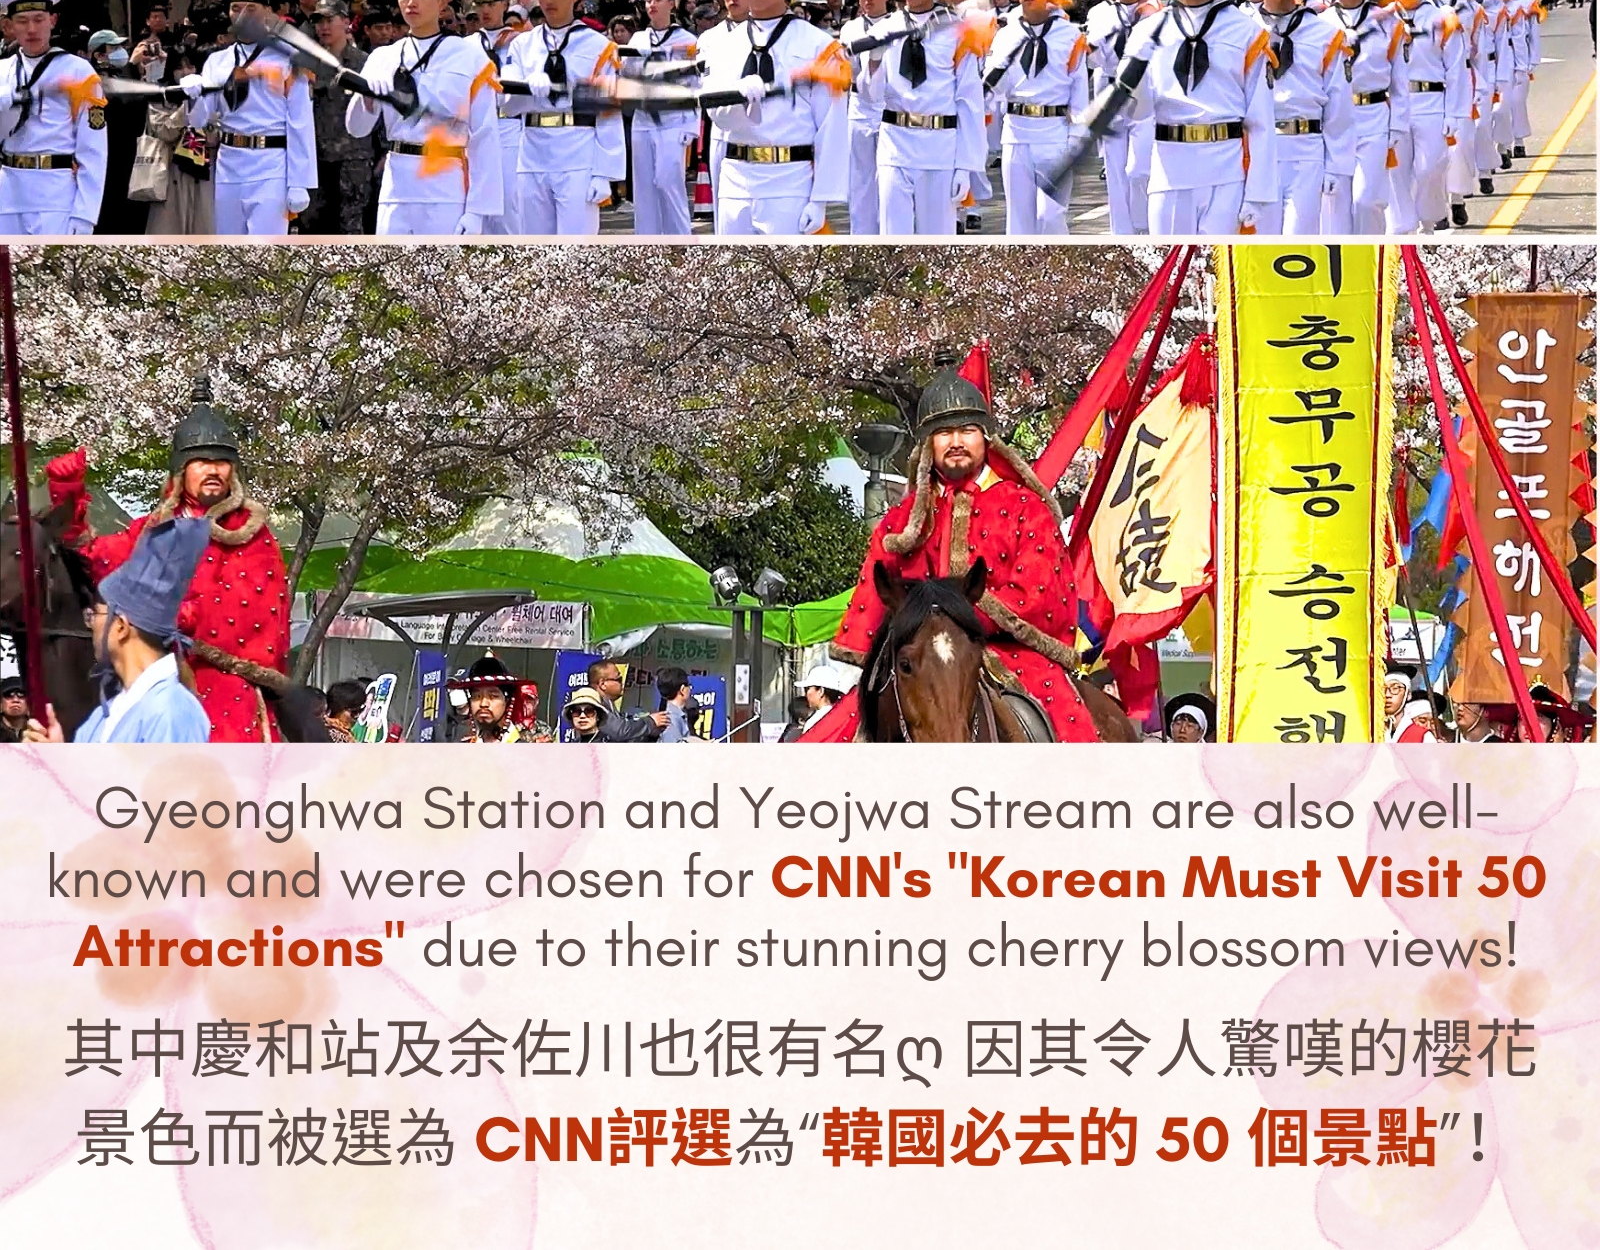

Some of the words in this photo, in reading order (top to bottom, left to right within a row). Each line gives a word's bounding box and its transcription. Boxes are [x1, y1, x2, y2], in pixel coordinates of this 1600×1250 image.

[1267, 245, 1355, 518] 이충무공
[550, 605, 573, 624] 대여
[424, 632, 435, 640] For
[548, 628, 575, 637] Service
